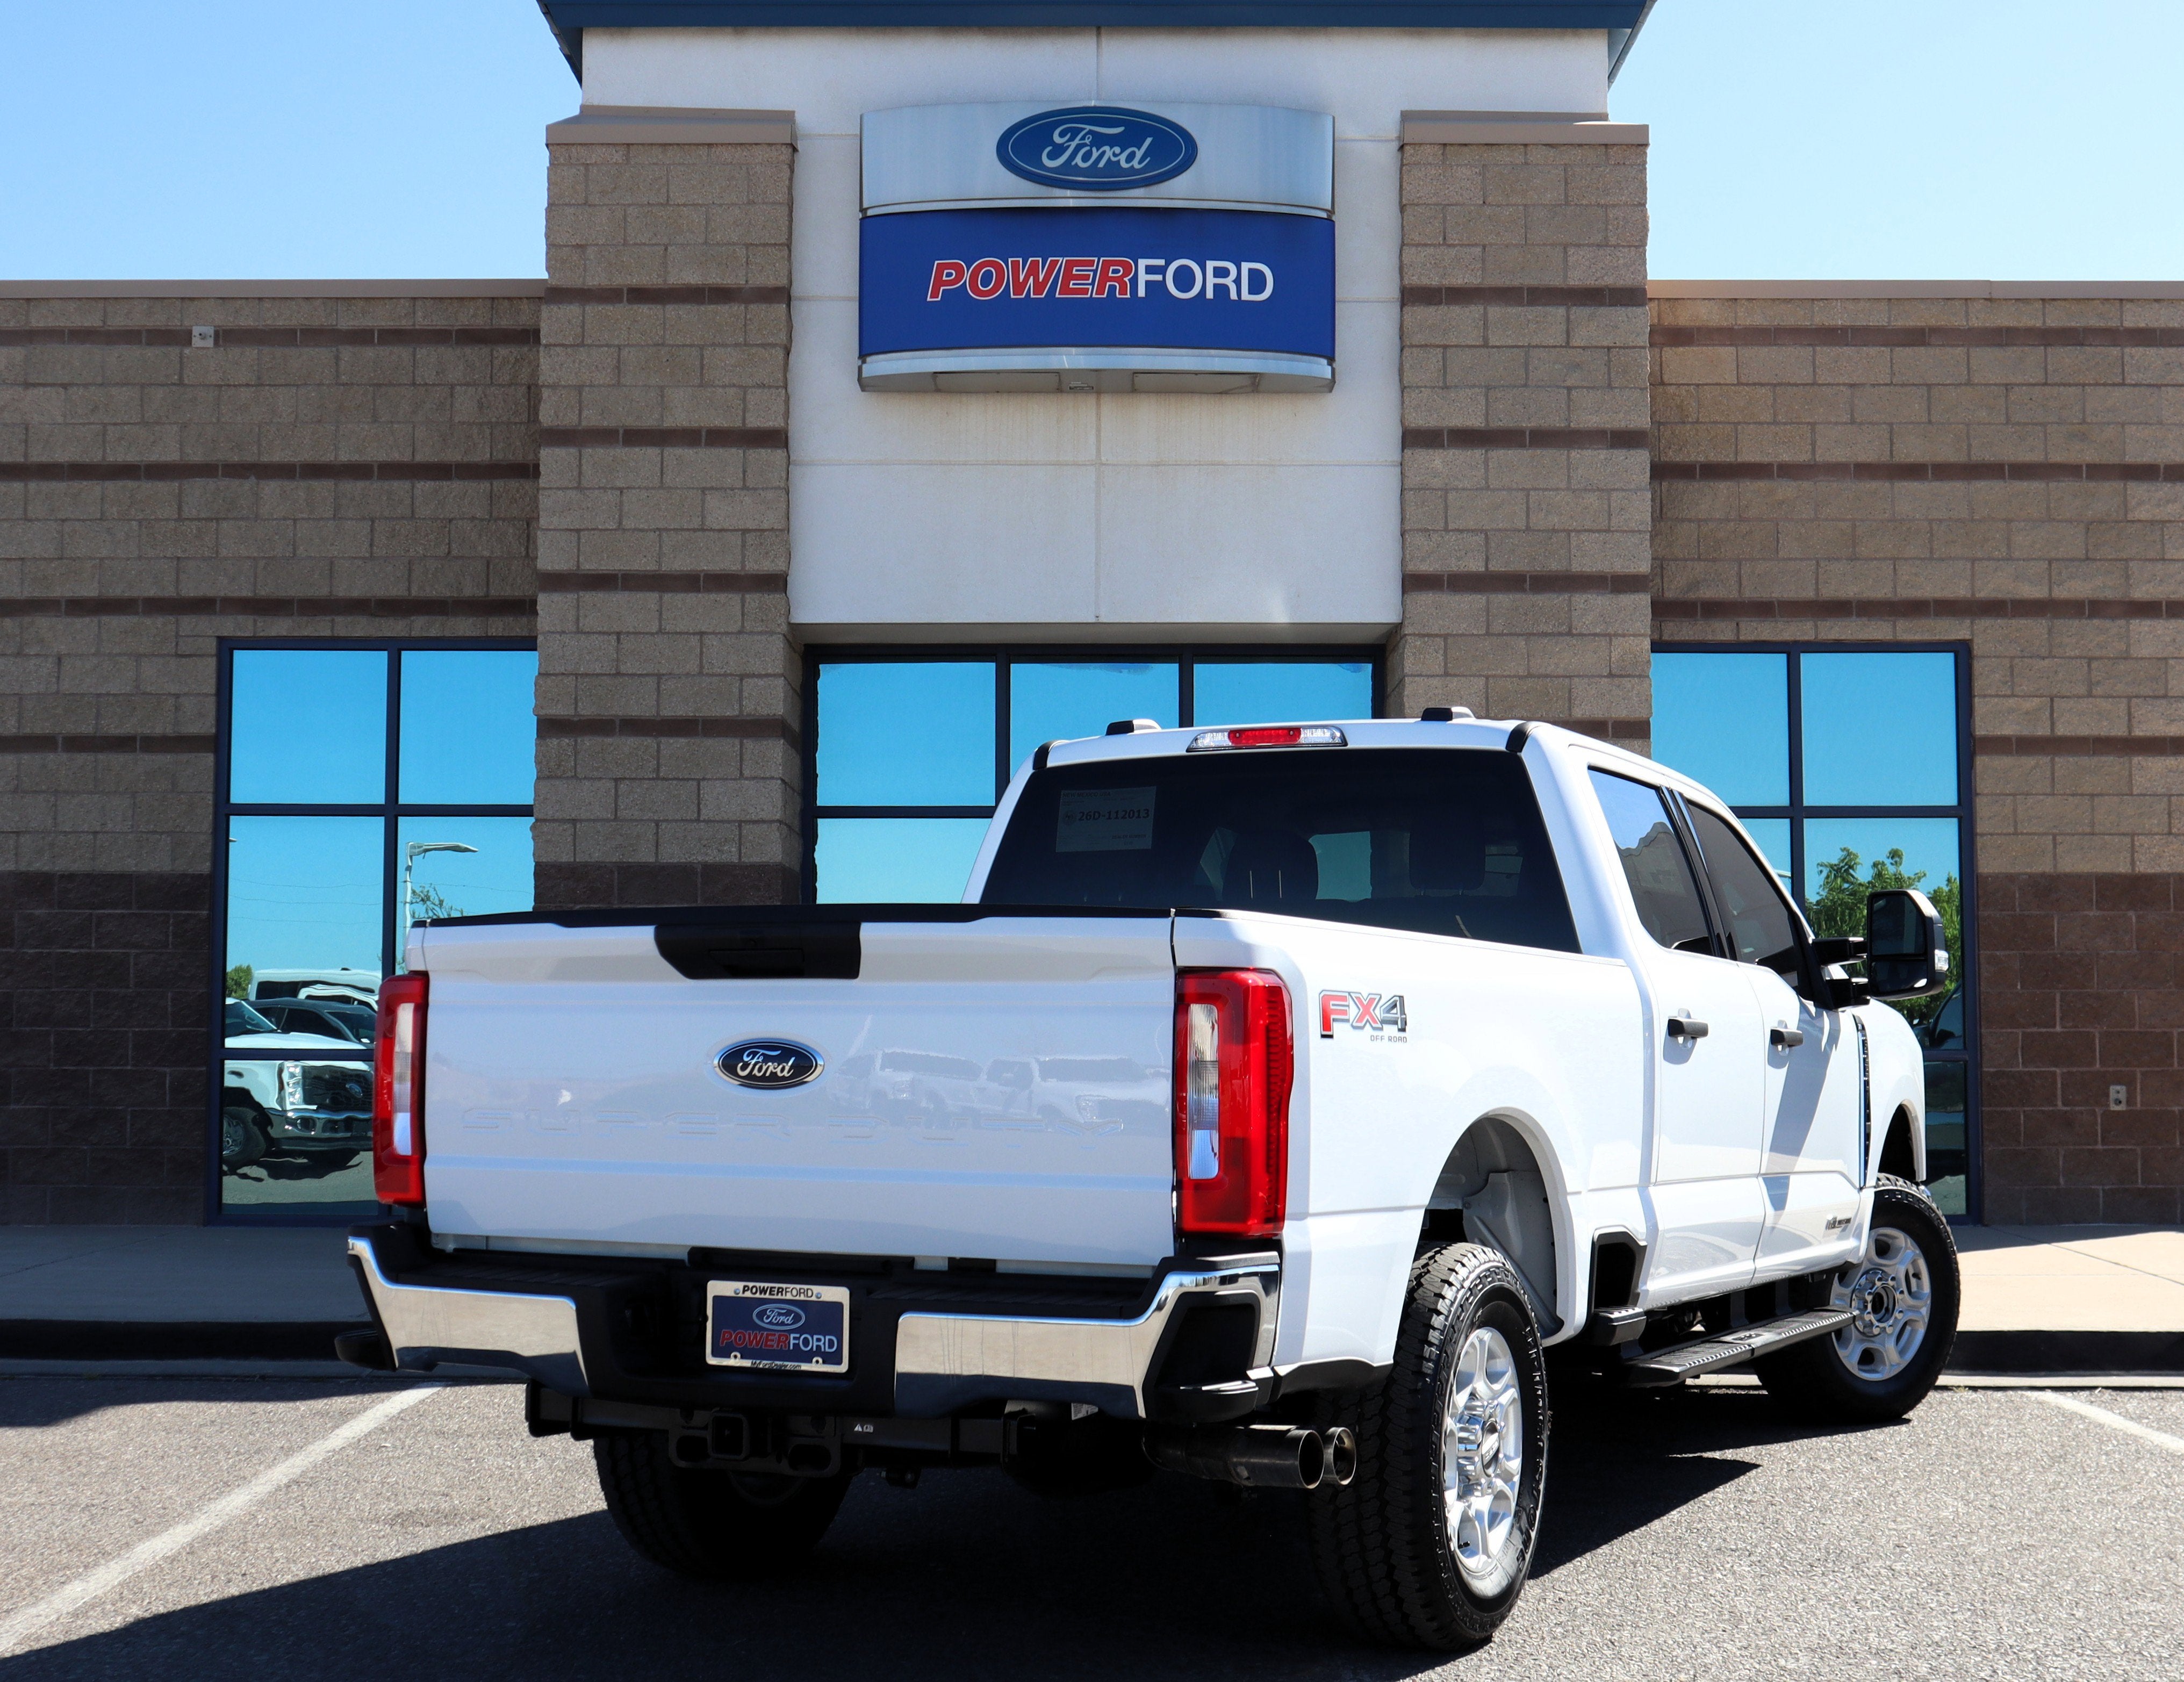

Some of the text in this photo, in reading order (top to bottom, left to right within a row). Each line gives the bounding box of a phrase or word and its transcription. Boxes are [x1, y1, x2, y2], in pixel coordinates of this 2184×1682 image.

[1041, 123, 1153, 169] Ford
[926, 256, 1274, 302] POWERFORD
[1078, 808, 1150, 821] 26D-112013
[1319, 989, 1407, 1039] FX4
[737, 1048, 796, 1077] Ford
[741, 1284, 814, 1298] POWERFORD
[763, 1307, 795, 1325] Ford
[719, 1329, 838, 1353] POWERFORD
